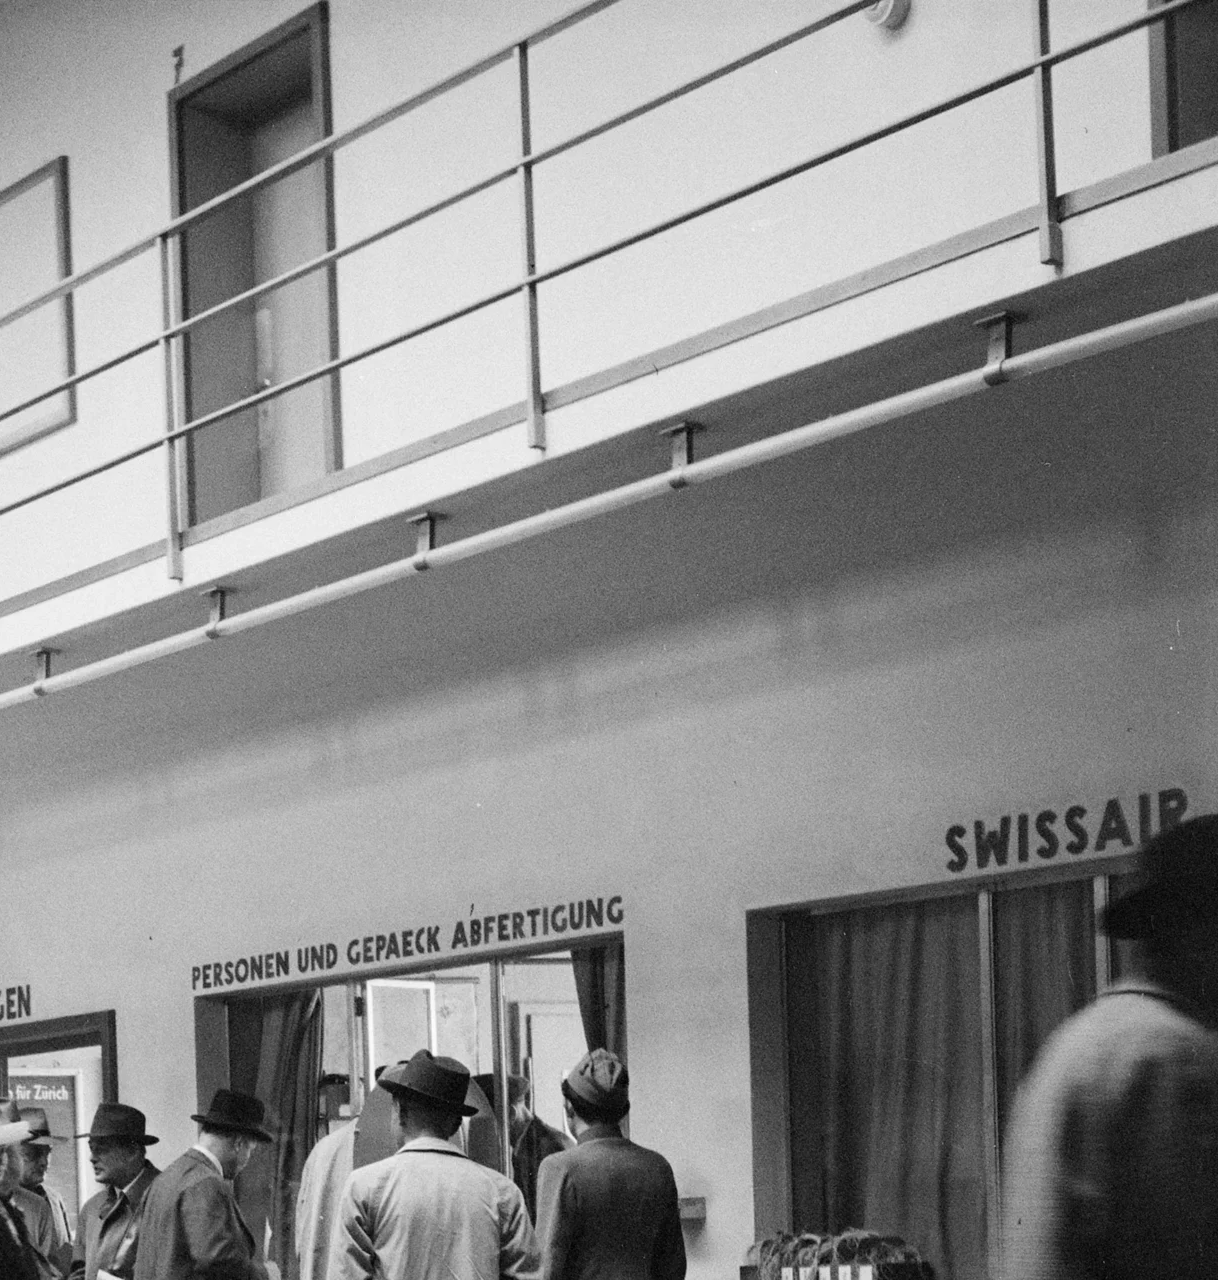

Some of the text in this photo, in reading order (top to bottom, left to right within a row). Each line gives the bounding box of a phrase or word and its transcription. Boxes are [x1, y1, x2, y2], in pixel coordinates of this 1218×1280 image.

[945, 788, 1188, 873] SWISSAIR
[191, 896, 625, 990] PERSONEN UND GEPAECK ABFERTIGUNG
[15, 1085, 31, 1100] für
[33, 1084, 69, 1101] Zürich
